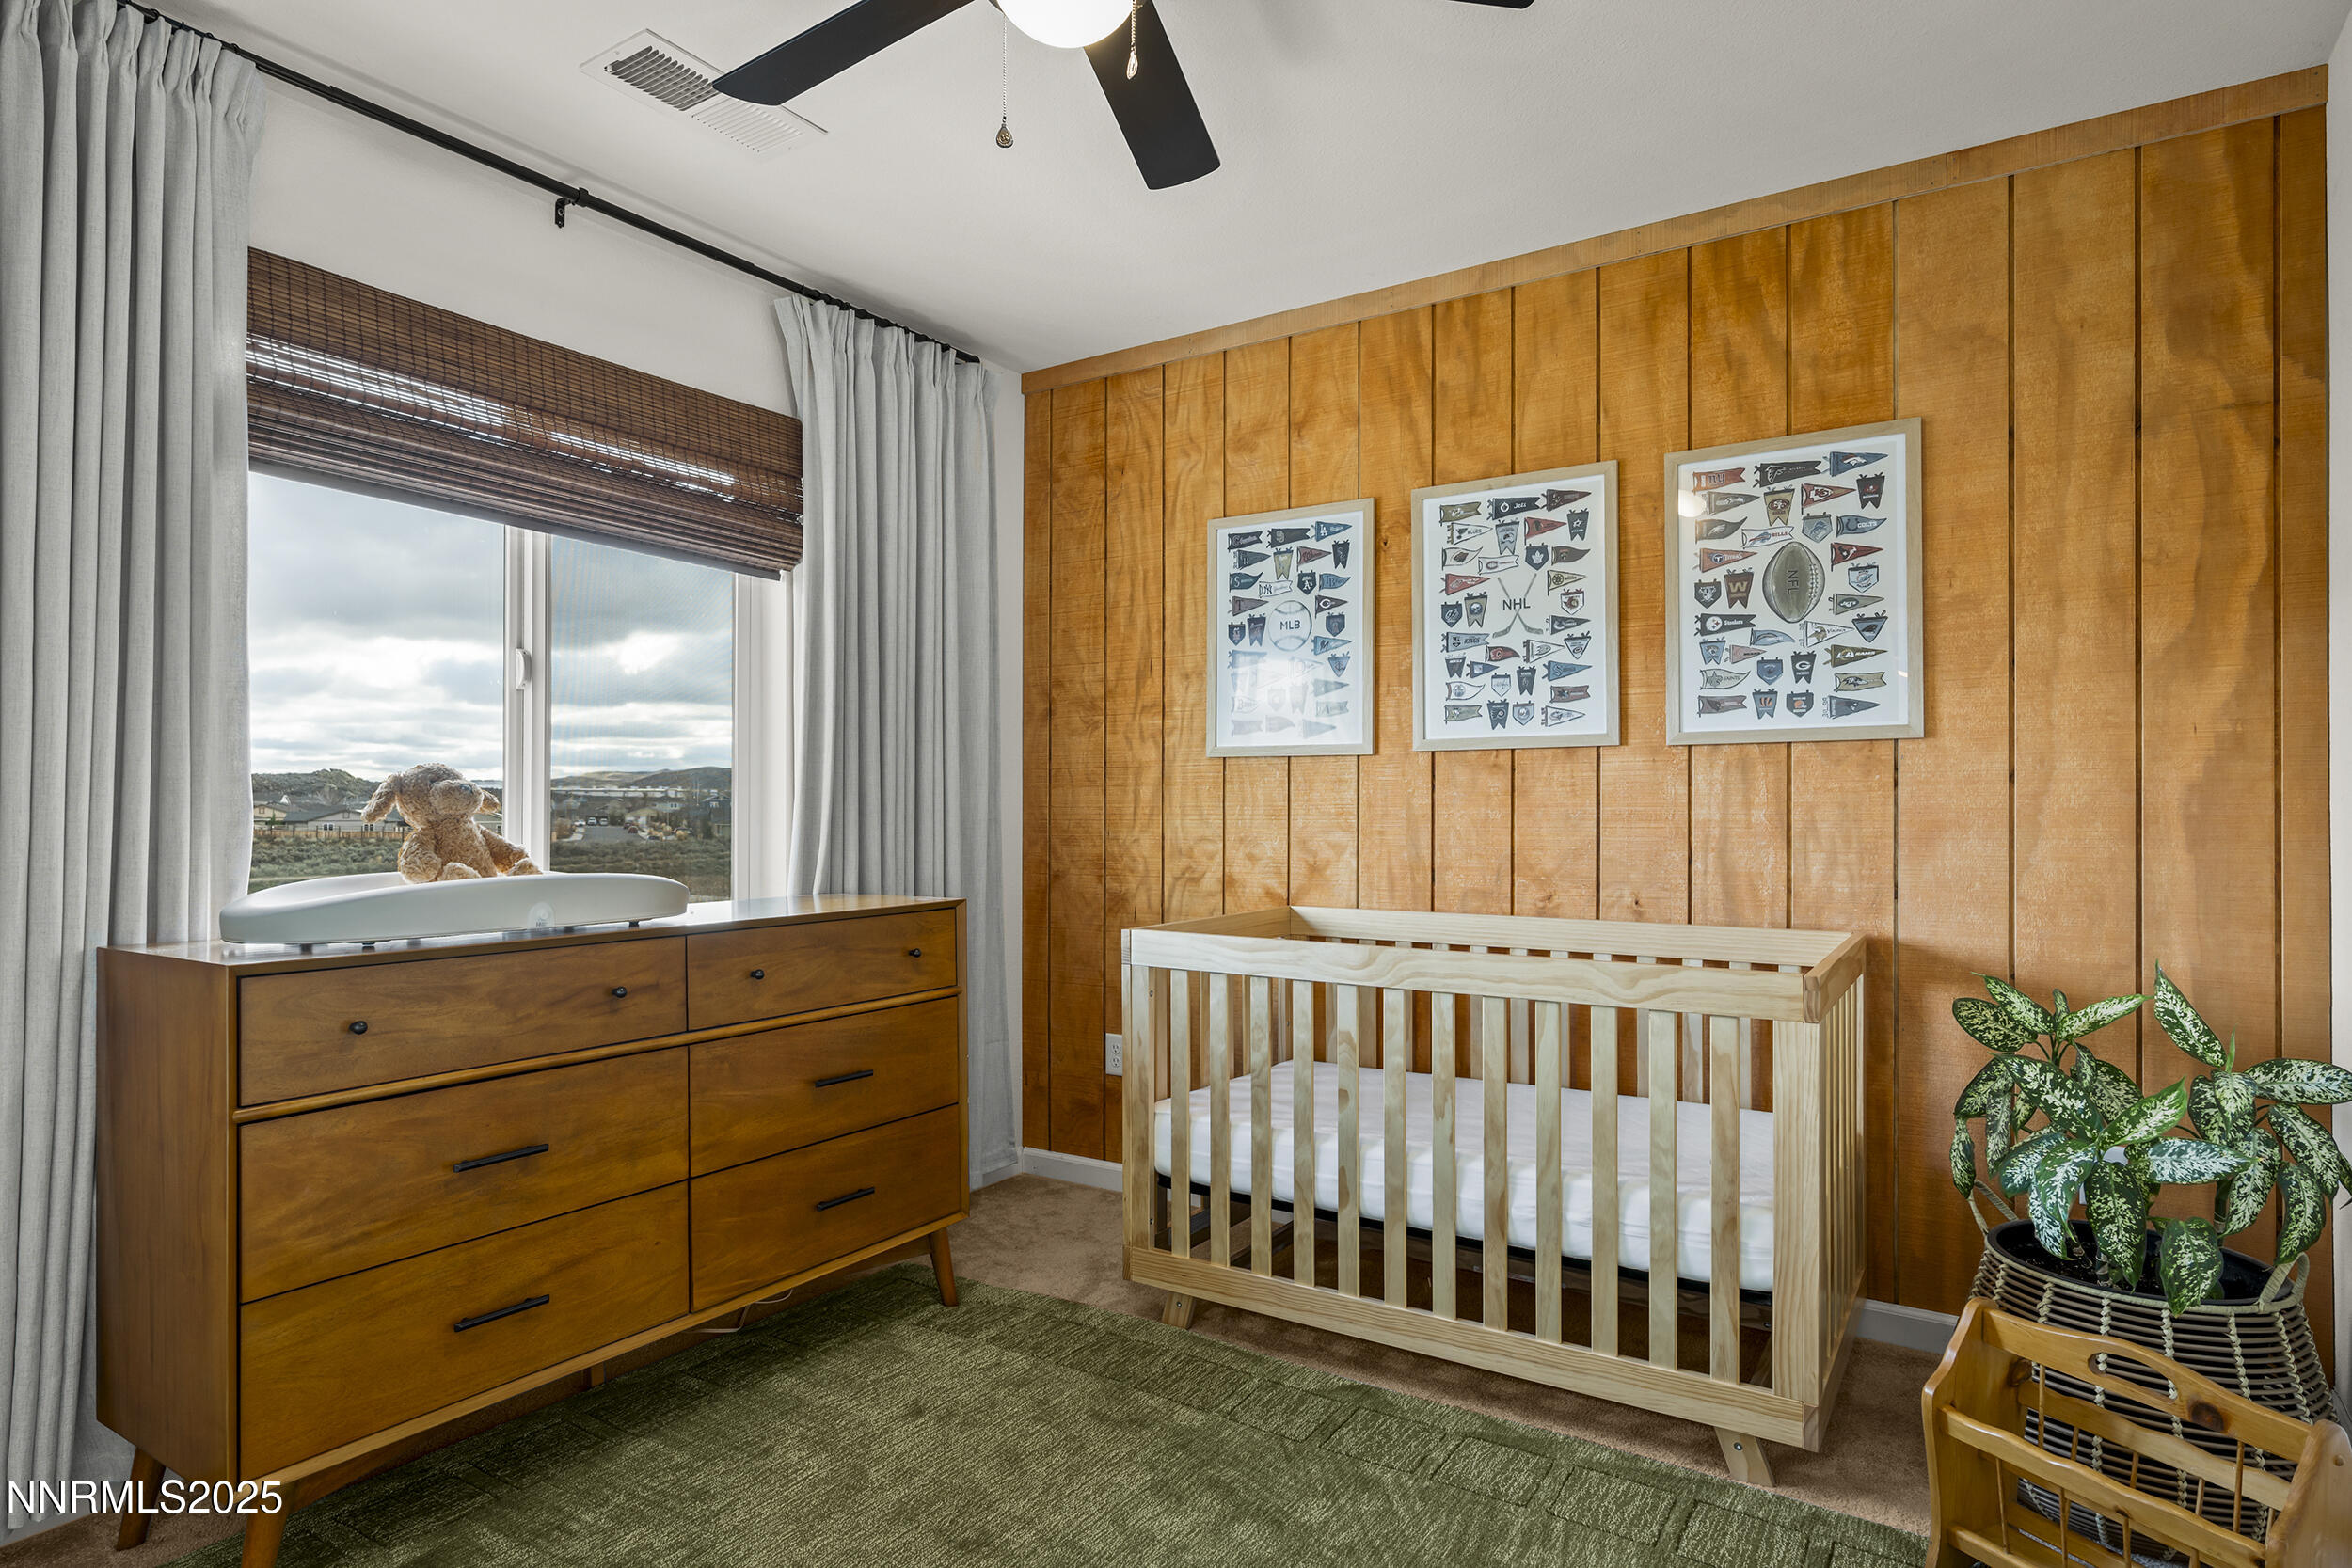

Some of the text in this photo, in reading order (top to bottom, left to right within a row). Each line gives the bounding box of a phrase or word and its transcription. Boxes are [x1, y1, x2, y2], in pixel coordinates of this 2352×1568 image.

[1787, 569, 1800, 595] NFL
[1502, 597, 1531, 610] NHL
[1279, 620, 1301, 631] MLB
